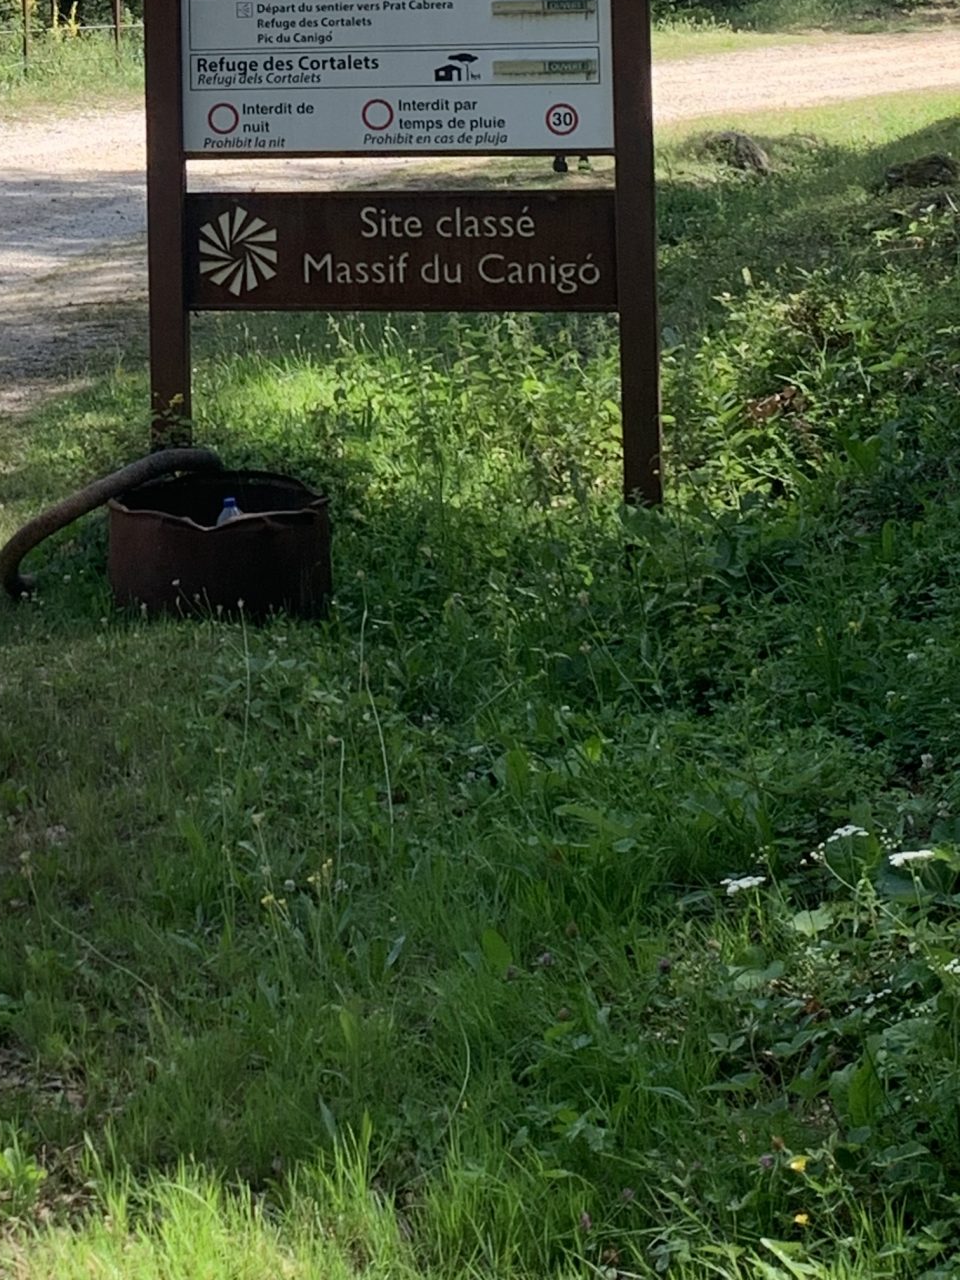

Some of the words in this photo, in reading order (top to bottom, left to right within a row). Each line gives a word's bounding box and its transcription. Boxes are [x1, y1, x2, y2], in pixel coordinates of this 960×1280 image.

[257, 2, 295, 17] Départ
[298, 2, 312, 13] du
[315, 1, 354, 13] sentier
[357, 3, 380, 12] vers
[383, 1, 406, 11] Prat
[409, 0, 454, 10] Cabrera
[257, 18, 296, 30] Refuge
[299, 18, 318, 28] des
[321, 17, 372, 27] Cortalets
[257, 33, 273, 44] Pic
[276, 33, 290, 43] du
[293, 31, 333, 45] Canigó
[197, 57, 258, 75] Refuge
[263, 56, 293, 71] des
[298, 55, 379, 70] Cortalets
[197, 73, 237, 87] Refugi
[239, 73, 263, 85] dels
[266, 72, 321, 84] Cortalets
[242, 103, 292, 115] Interdit
[296, 103, 314, 115] de
[398, 99, 449, 111] Interdit
[454, 101, 477, 113] par
[399, 118, 443, 131] temps
[447, 117, 465, 129] de
[470, 117, 505, 131] pluie
[552, 112, 573, 127] 30
[242, 121, 270, 133] nuit
[203, 137, 252, 149] Prohibit
[255, 137, 266, 148] la
[268, 136, 285, 148] nit
[363, 133, 413, 144] Prohibit
[416, 135, 431, 144] en
[434, 135, 454, 144] cas
[457, 132, 471, 143] de
[475, 132, 508, 146] pluja
[360, 207, 423, 238] Site
[436, 206, 536, 238] classé
[304, 252, 409, 284] Massif
[420, 252, 462, 284] du
[478, 252, 600, 294] Canigó
